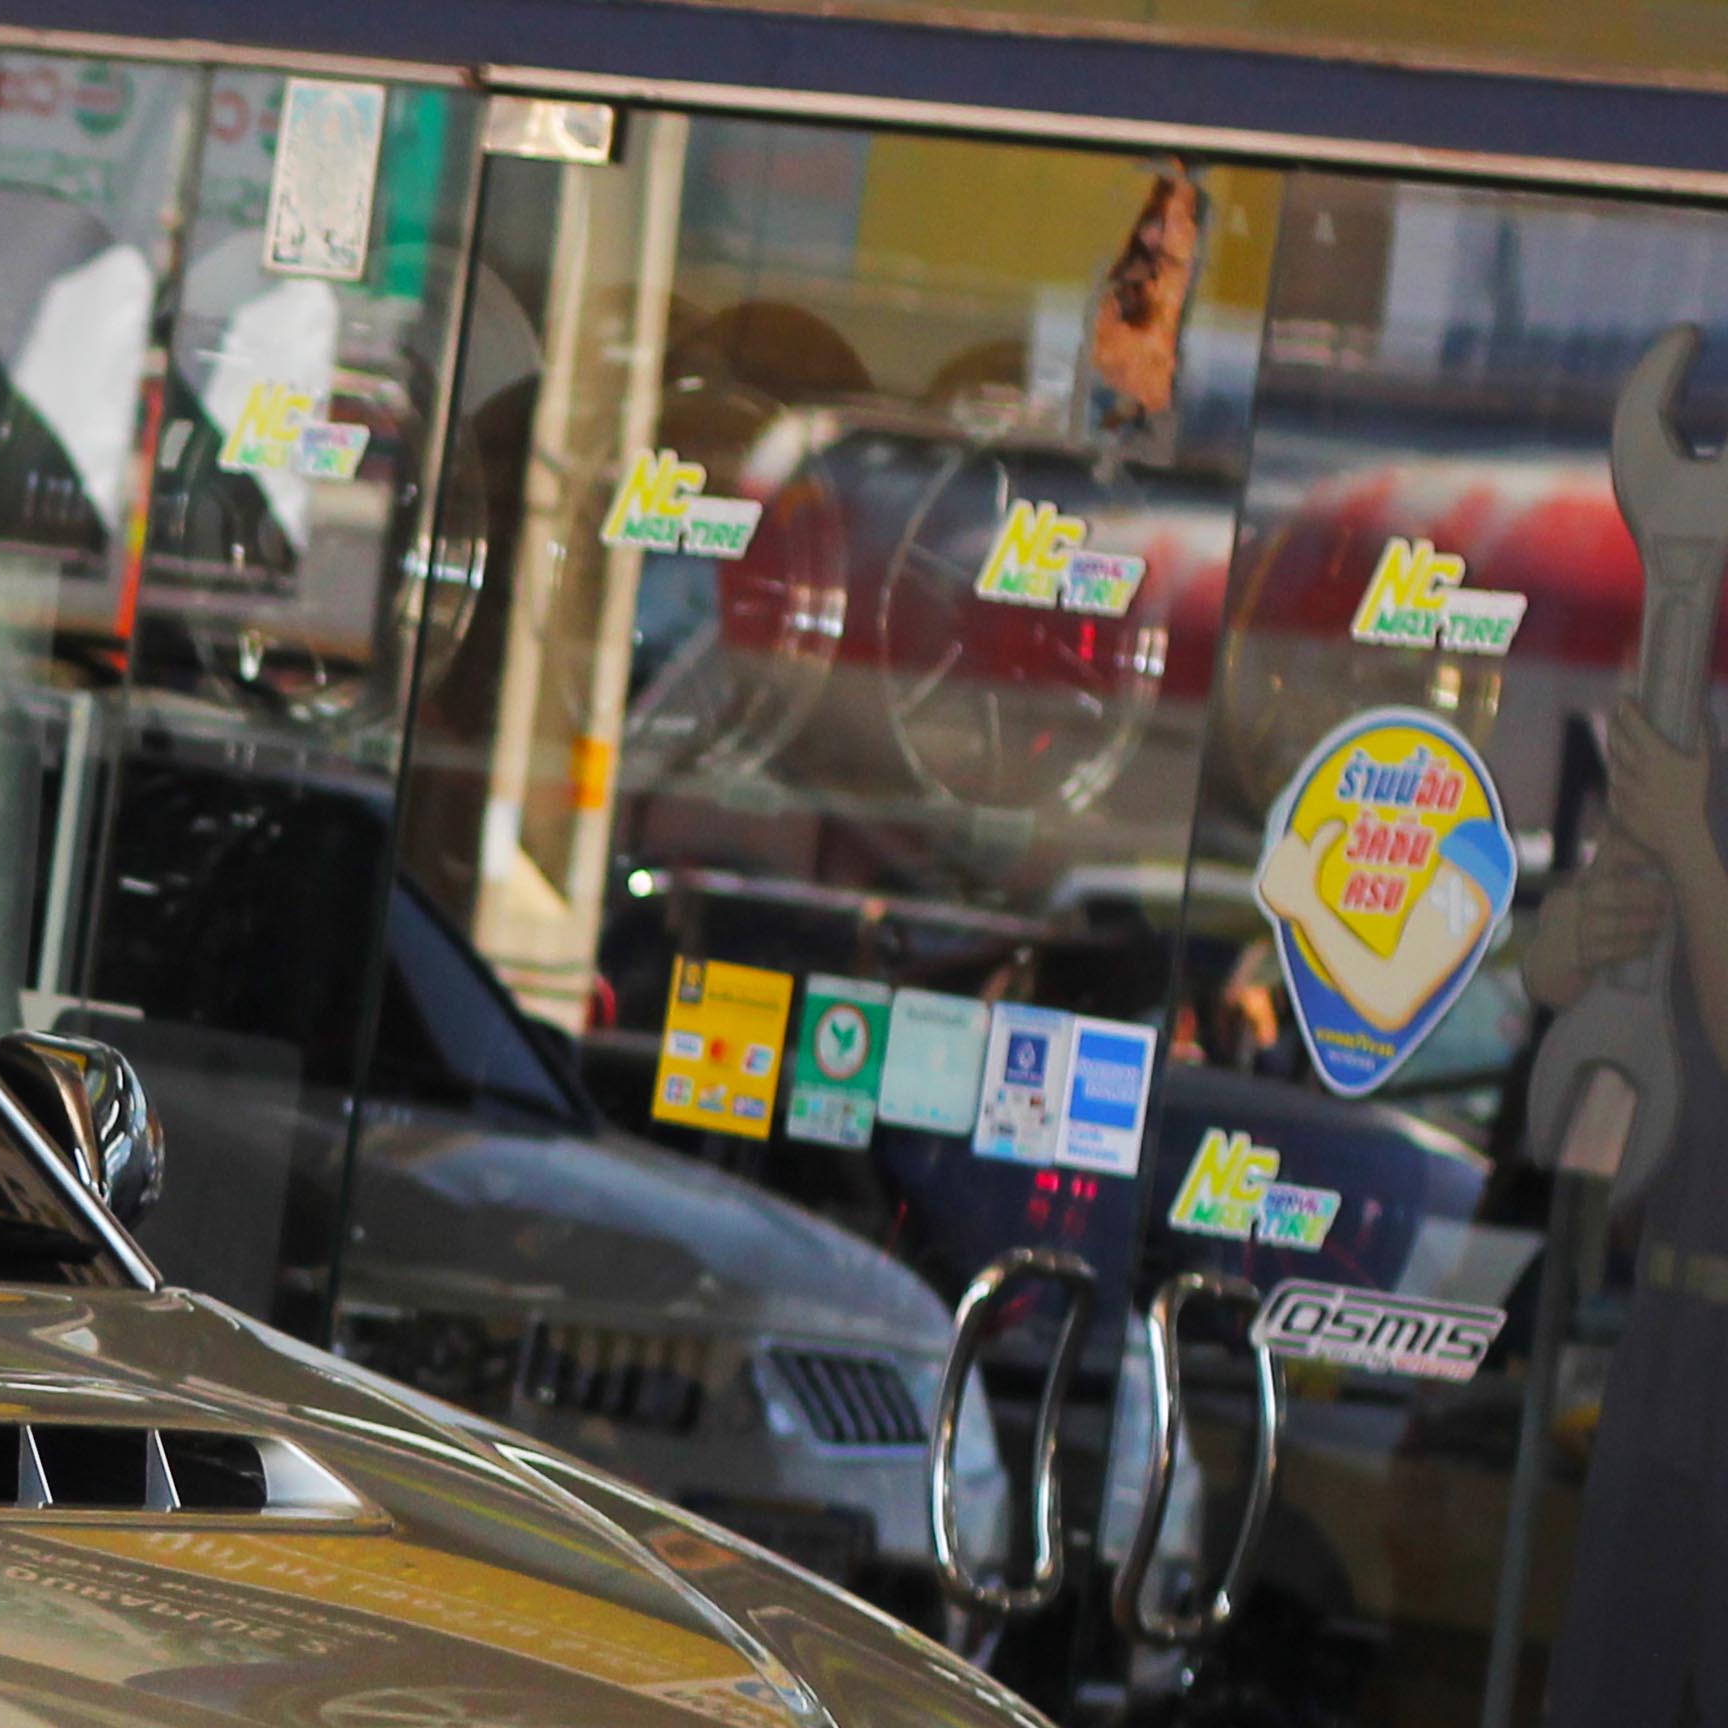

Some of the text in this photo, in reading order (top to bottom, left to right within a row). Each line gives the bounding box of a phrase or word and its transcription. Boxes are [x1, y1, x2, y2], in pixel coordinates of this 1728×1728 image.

[607, 455, 702, 538] NC
[982, 506, 1082, 590] NC
[1357, 546, 1459, 632] NC
[1176, 1136, 1277, 1219] NC
